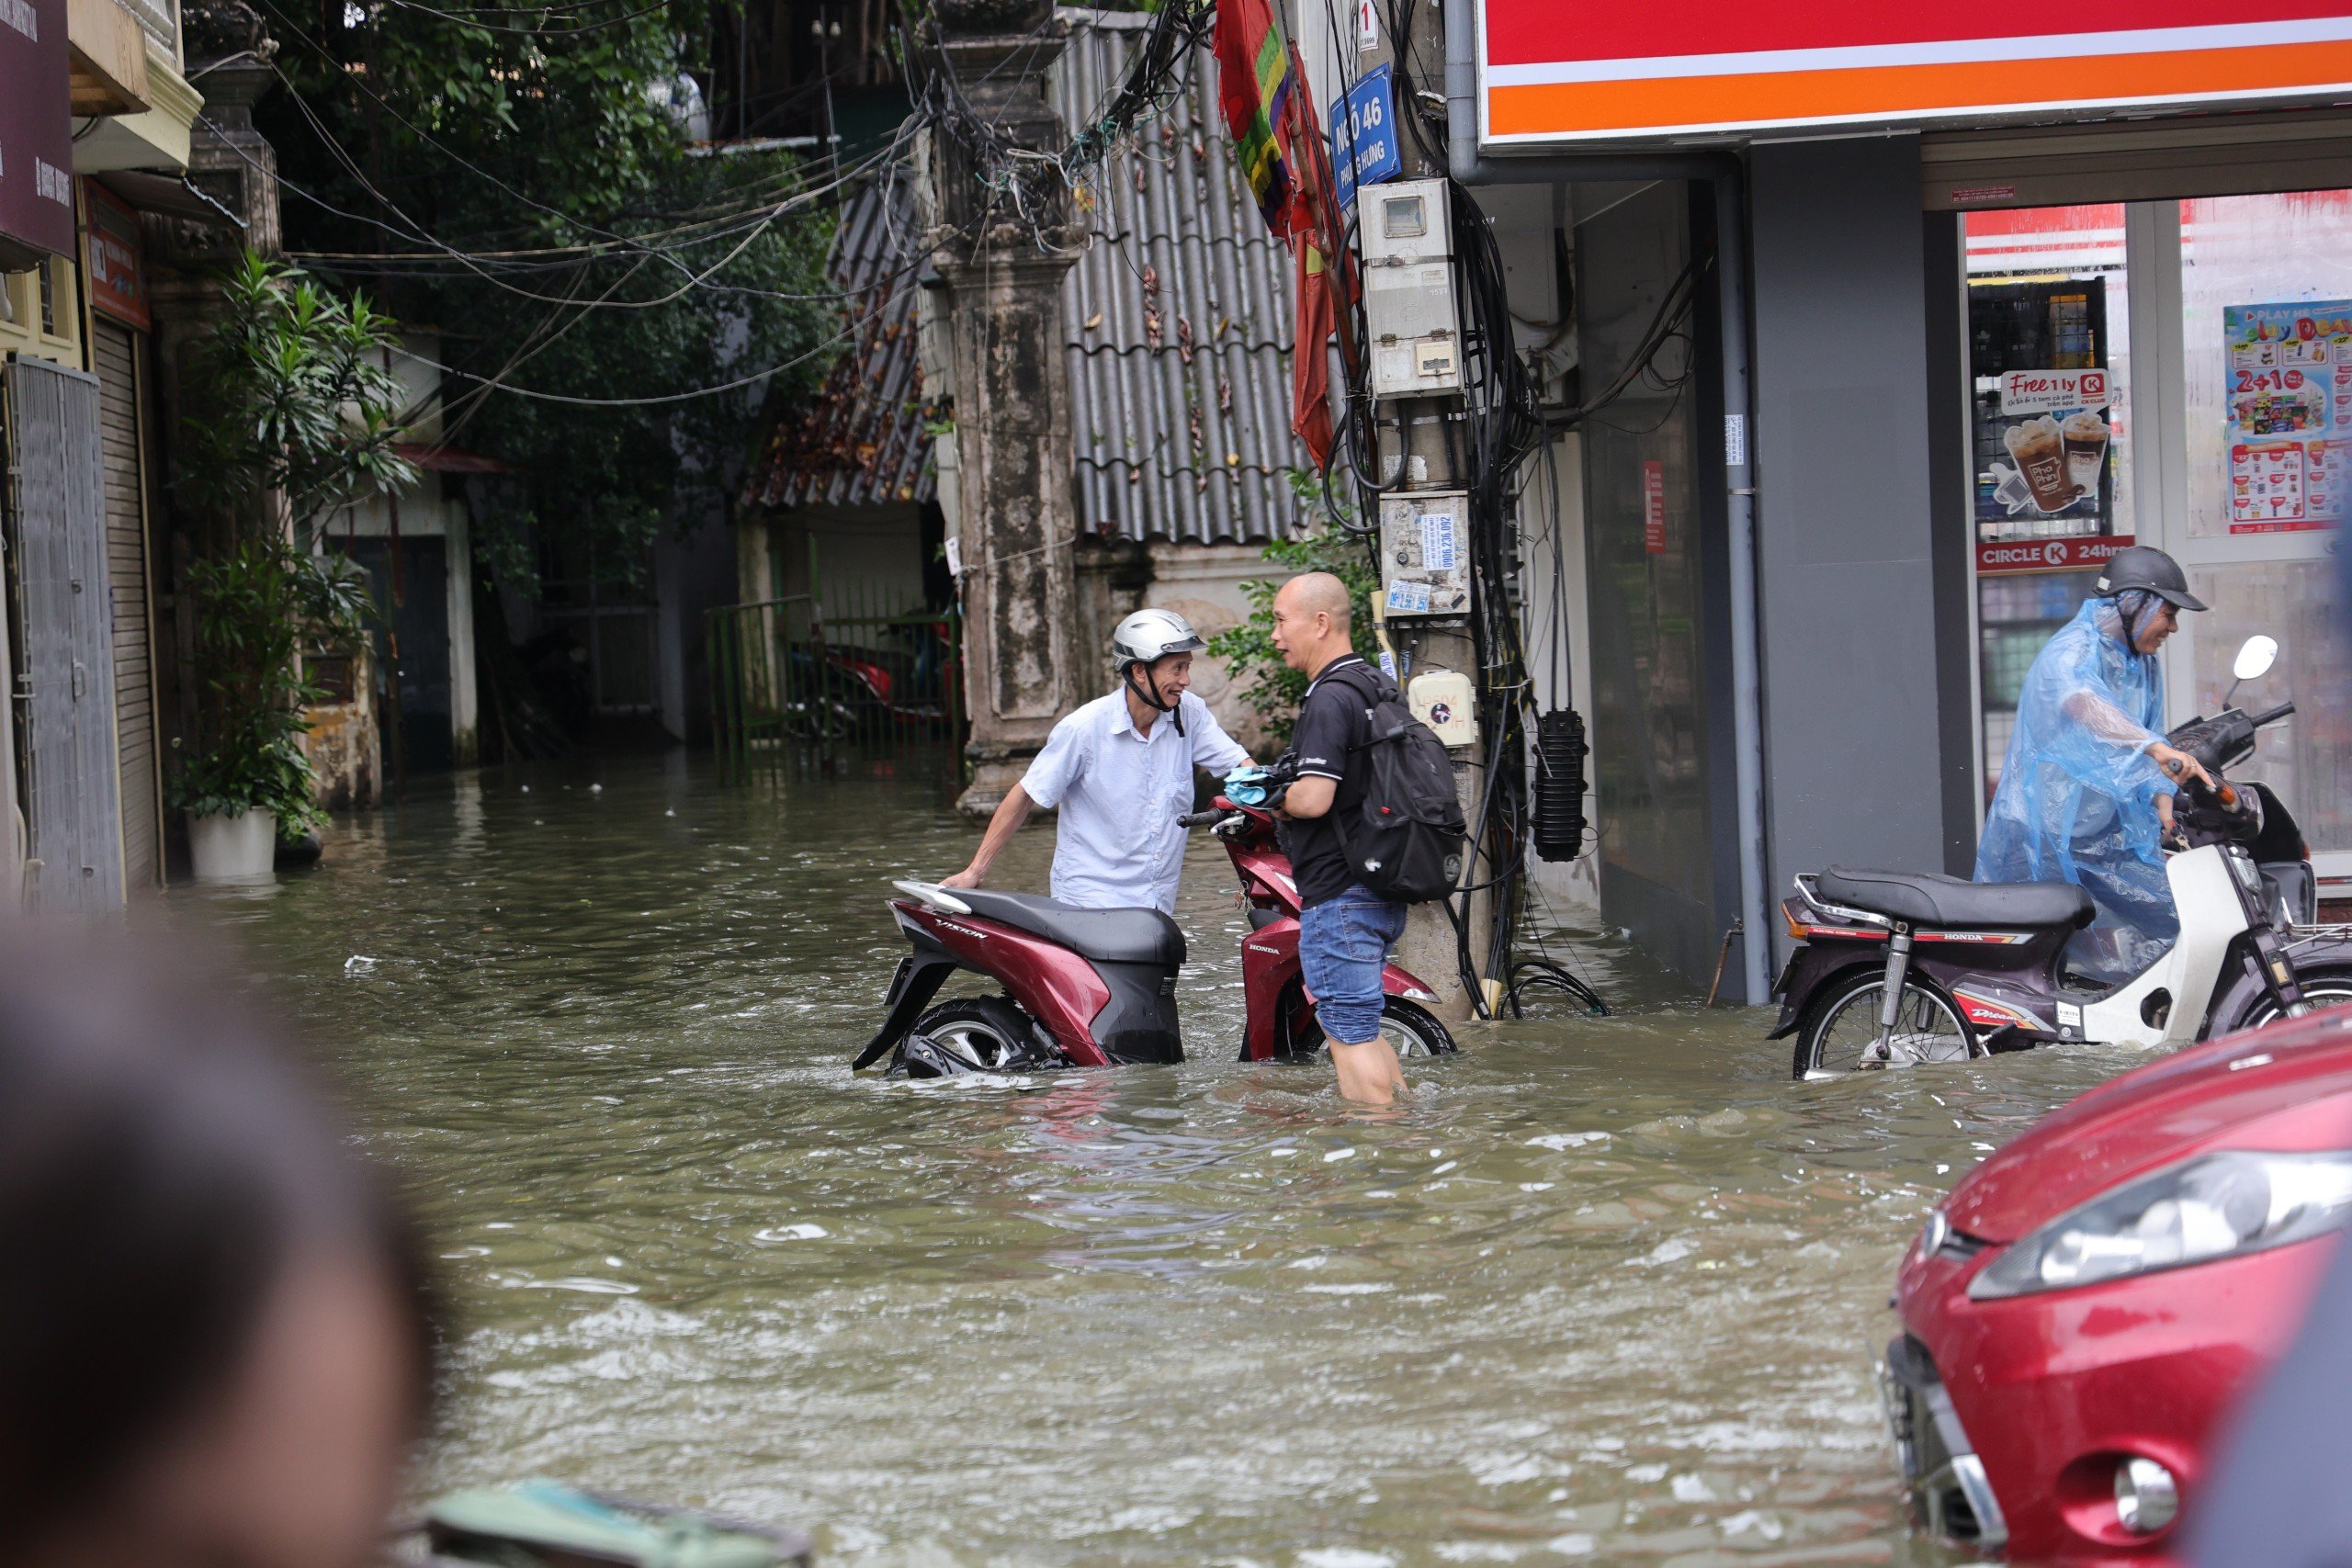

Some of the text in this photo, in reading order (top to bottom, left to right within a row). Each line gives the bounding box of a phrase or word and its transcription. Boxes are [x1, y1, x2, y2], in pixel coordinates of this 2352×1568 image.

[1363, 96, 1382, 130] 46
[1362, 140, 1385, 172] HƯNG
[2009, 373, 2050, 397] Free
[2052, 379, 2058, 391] 1
[2062, 378, 2076, 392] ly
[2235, 369, 2282, 392] 2+1
[1983, 547, 2041, 564] CIRCLE
[2078, 544, 2125, 558] 24hr
[935, 918, 989, 939] VISION
[1250, 943, 1280, 955] HONDA
